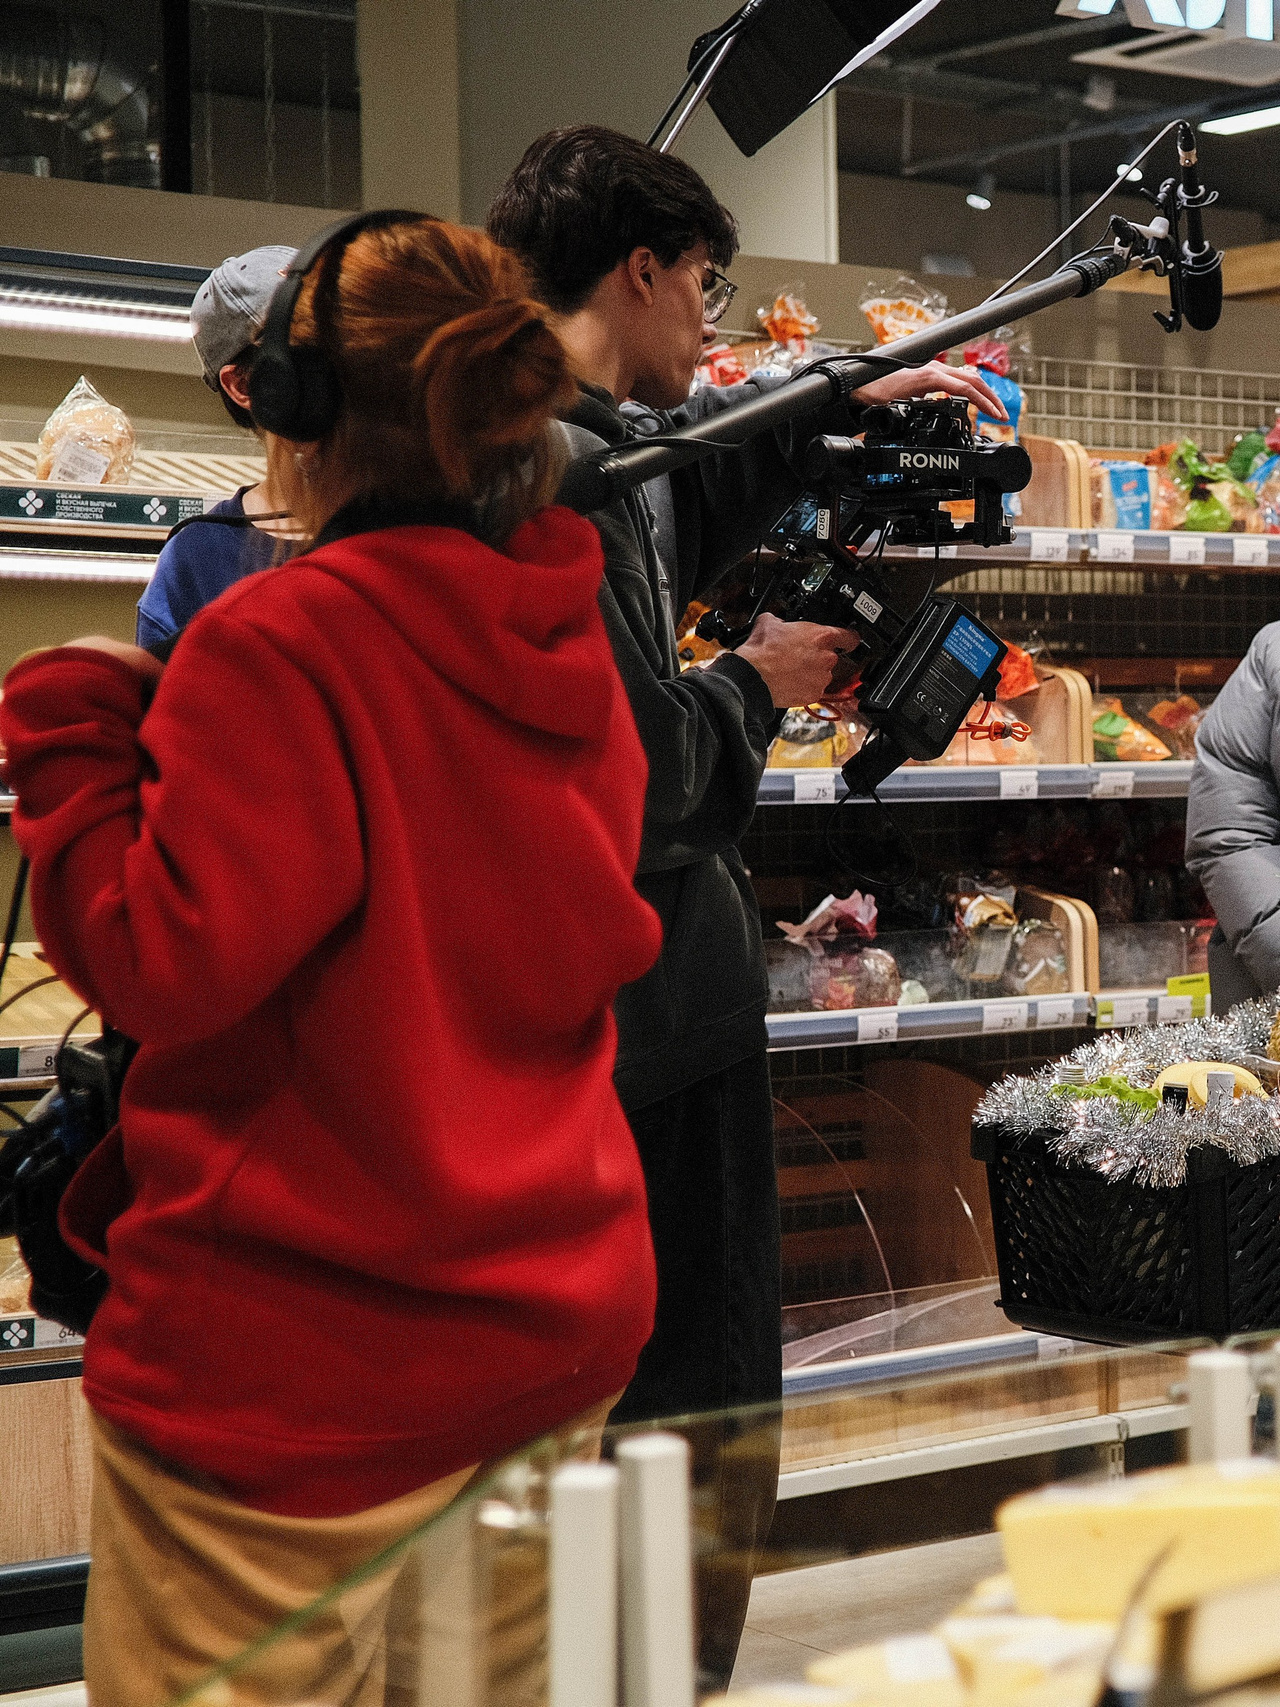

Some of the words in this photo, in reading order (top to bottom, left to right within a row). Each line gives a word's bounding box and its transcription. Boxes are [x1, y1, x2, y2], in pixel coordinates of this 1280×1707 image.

[899, 453, 960, 470] RONIN
[818, 509, 826, 537] 7080
[58, 1327, 76, 1339] 64
